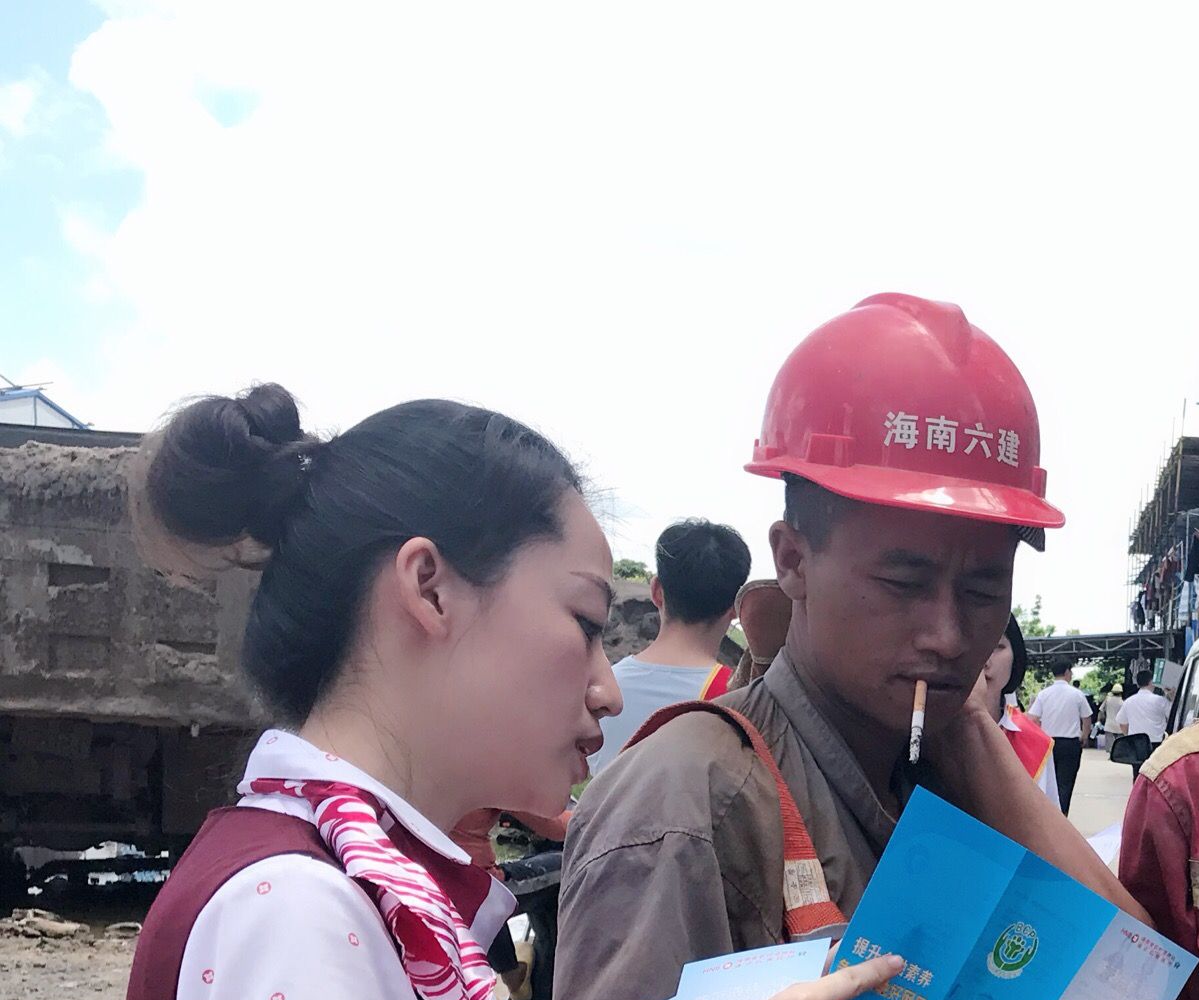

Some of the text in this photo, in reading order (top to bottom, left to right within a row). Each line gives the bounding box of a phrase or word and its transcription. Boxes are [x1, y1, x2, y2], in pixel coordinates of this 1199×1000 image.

[883, 411, 1020, 468] 海南六建
[852, 937, 934, 988] 提升素养
